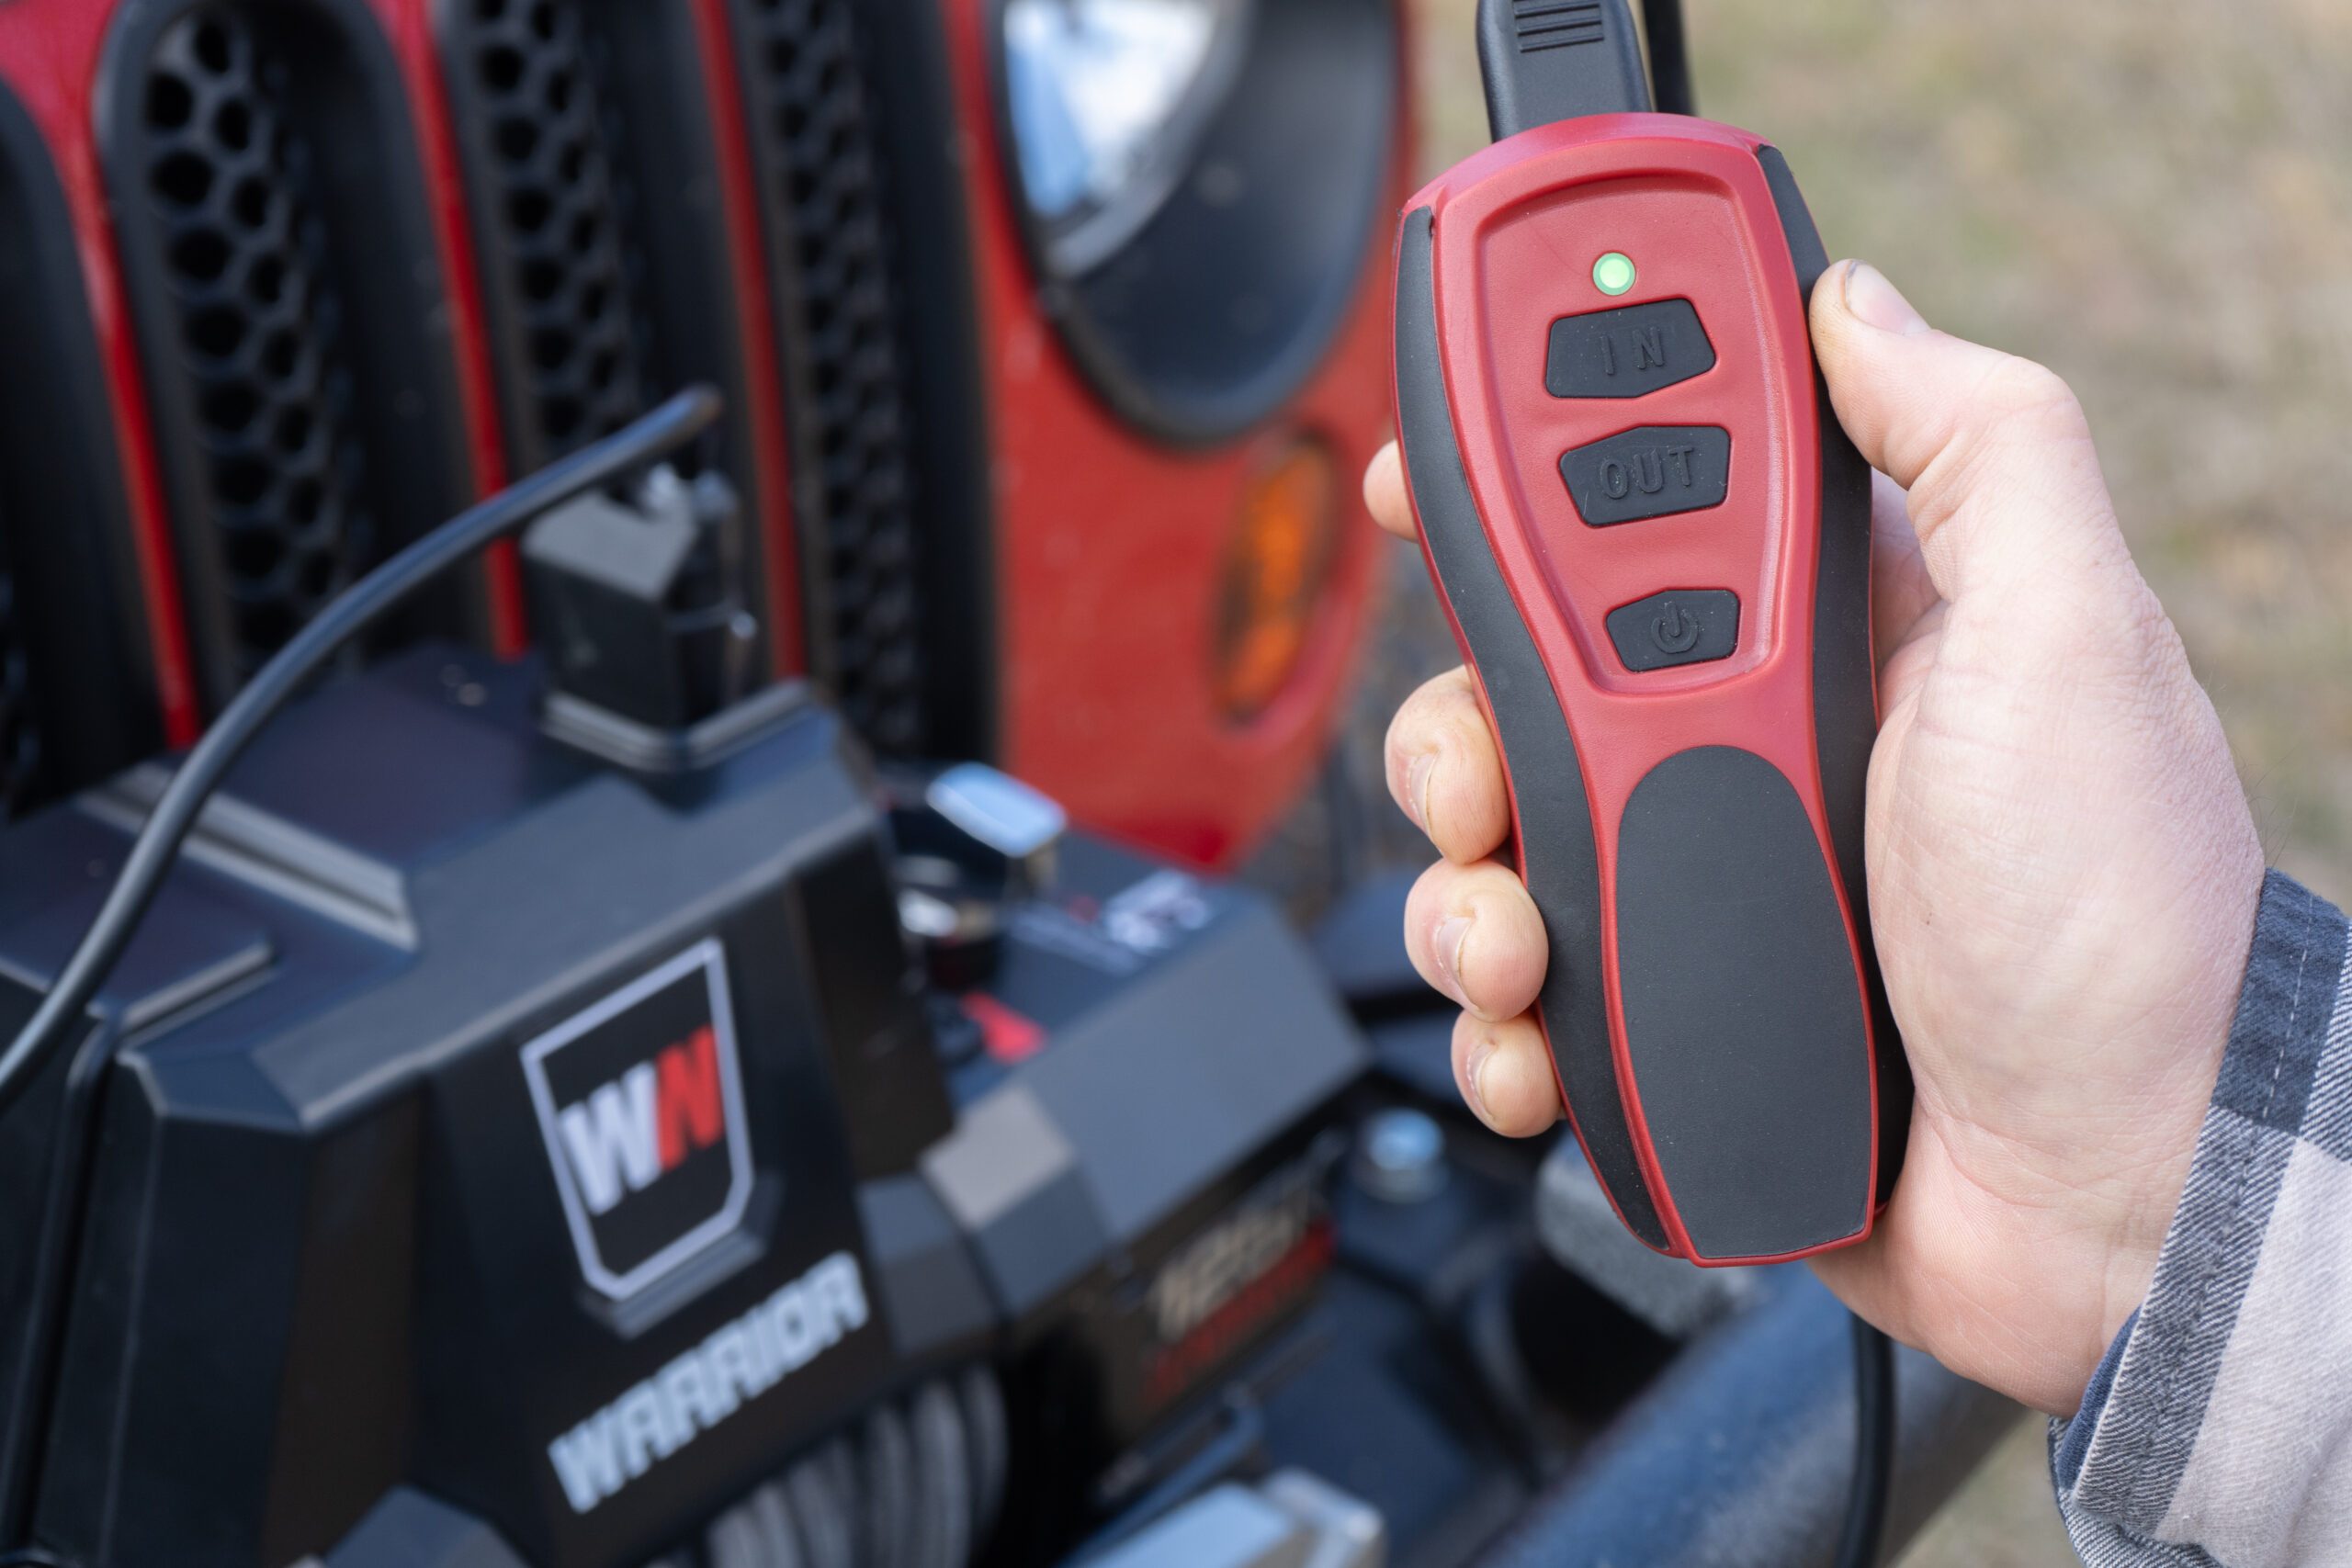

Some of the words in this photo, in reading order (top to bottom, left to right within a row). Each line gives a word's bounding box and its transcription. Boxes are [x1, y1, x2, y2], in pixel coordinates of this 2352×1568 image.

[1601, 328, 1665, 375] IN
[1600, 446, 1695, 499] OUT
[548, 1250, 870, 1515] WARRIOR
